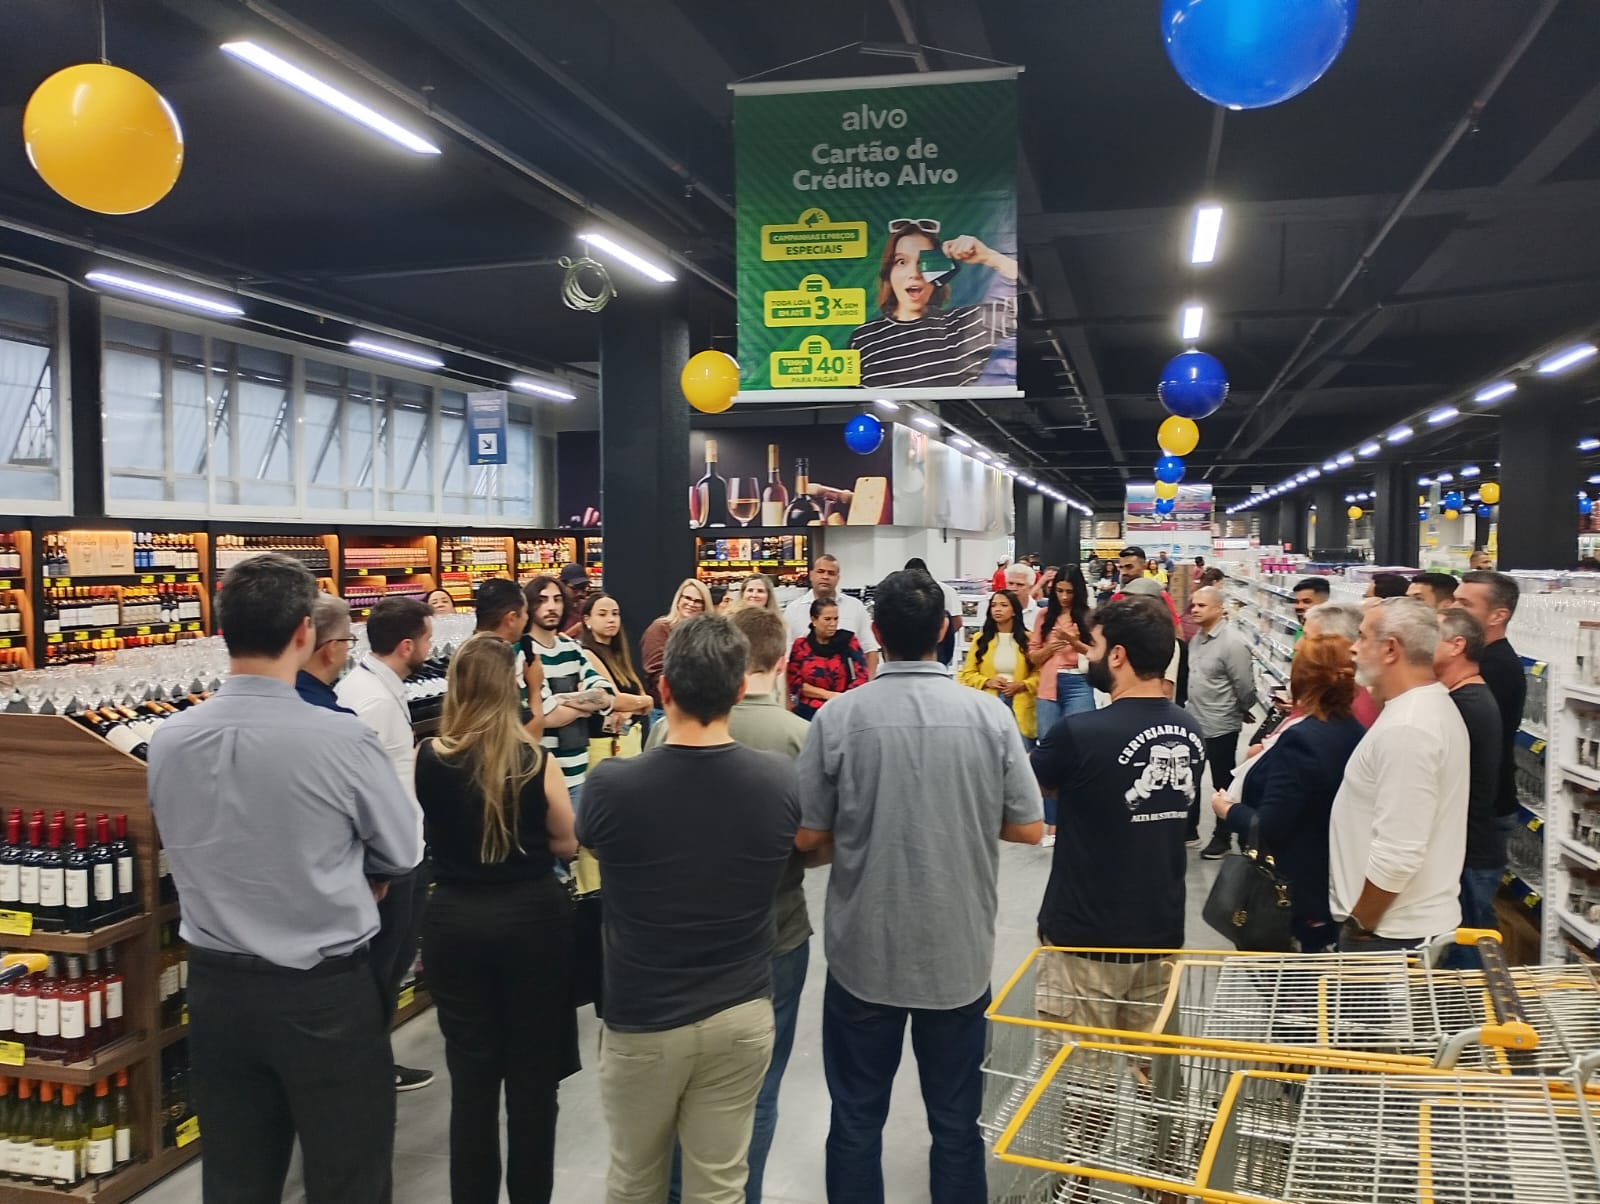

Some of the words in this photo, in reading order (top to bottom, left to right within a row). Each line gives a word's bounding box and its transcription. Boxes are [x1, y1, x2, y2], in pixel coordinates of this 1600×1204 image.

[842, 104, 908, 131] alvo
[811, 140, 900, 165] Cartão
[906, 137, 939, 160] de
[792, 167, 891, 191] Crédito
[897, 162, 959, 186] Alvo
[786, 245, 843, 255] ESPECIAIS
[815, 296, 830, 320] 3
[816, 356, 844, 375] 40
[1118, 725, 1187, 765] CERVEJARIA
